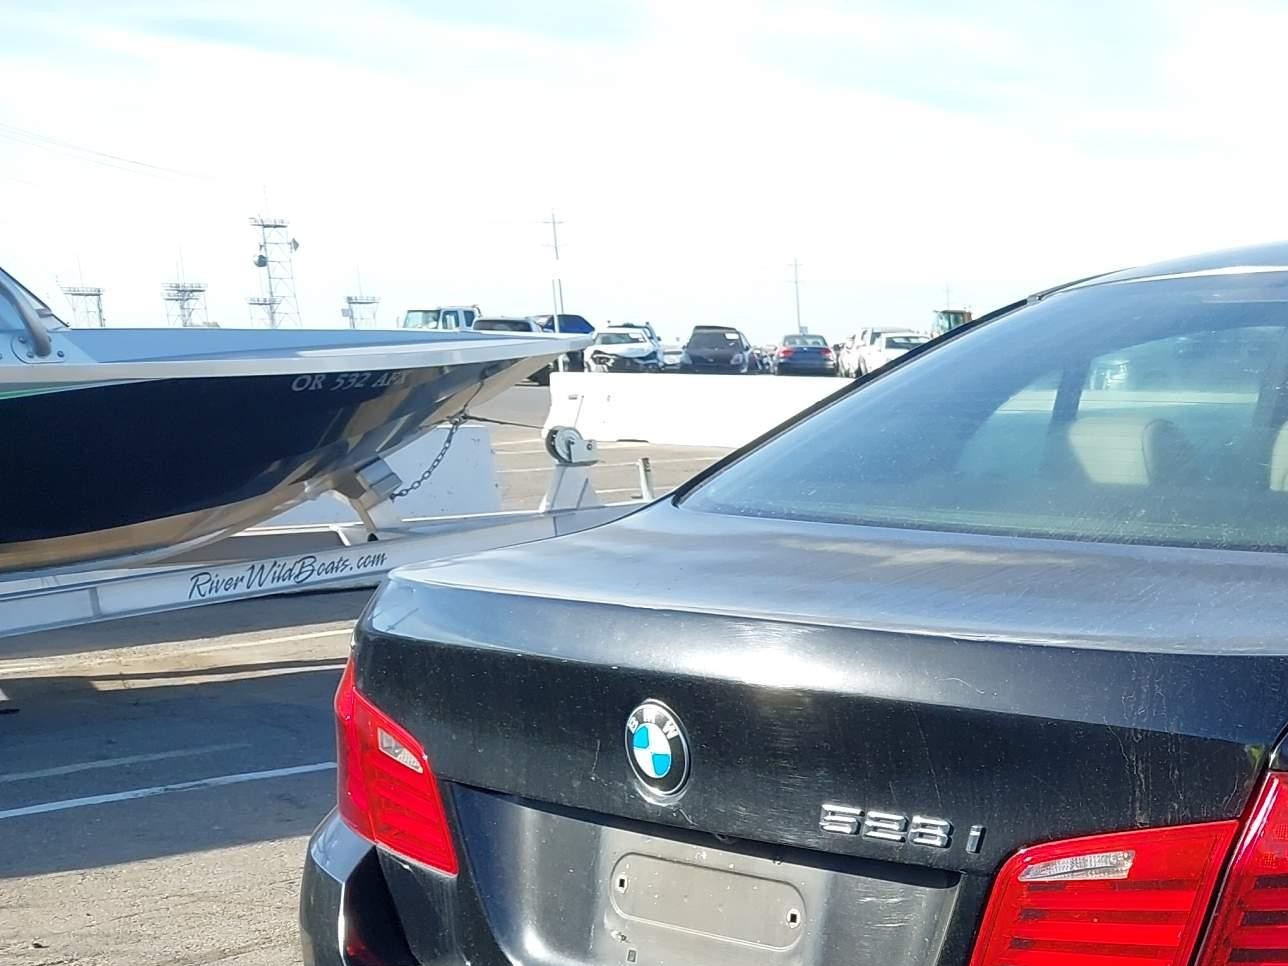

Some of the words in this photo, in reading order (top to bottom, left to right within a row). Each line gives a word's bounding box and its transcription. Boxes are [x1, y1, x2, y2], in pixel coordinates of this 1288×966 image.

[291, 374, 326, 392] OR
[330, 372, 371, 391] 532
[188, 552, 387, 600] RiverWildBoats.com
[627, 708, 680, 740] BMW
